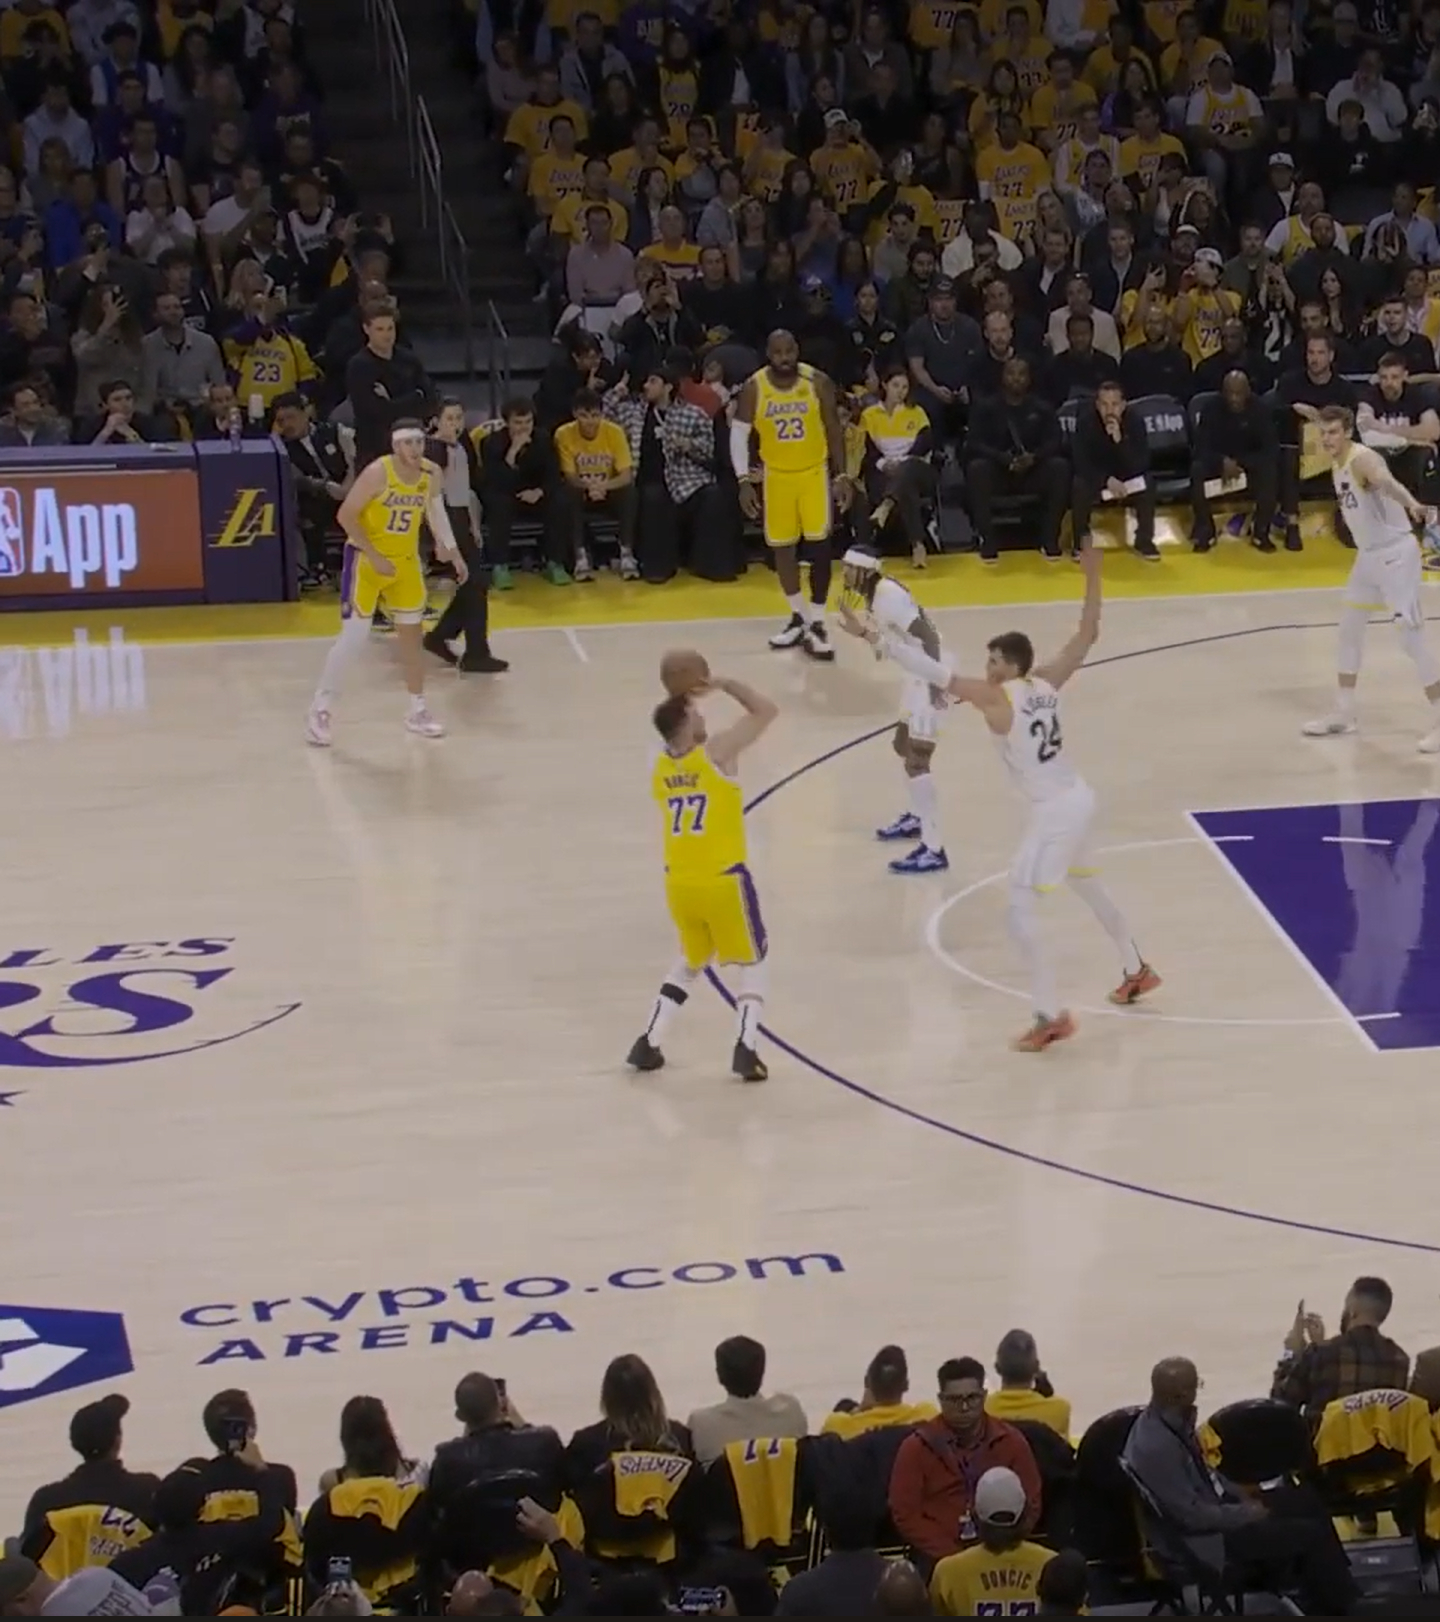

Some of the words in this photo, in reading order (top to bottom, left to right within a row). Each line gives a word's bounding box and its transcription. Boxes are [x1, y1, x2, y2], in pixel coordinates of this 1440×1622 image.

[254, 362, 281, 382] 23
[776, 418, 804, 439] 23
[388, 508, 412, 532] 15
[31, 487, 137, 588] App
[668, 794, 708, 833] 77
[180, 1252, 846, 1328] crypto.com
[196, 1311, 575, 1366] ARENA
[619, 1454, 694, 1482] LAKERS
